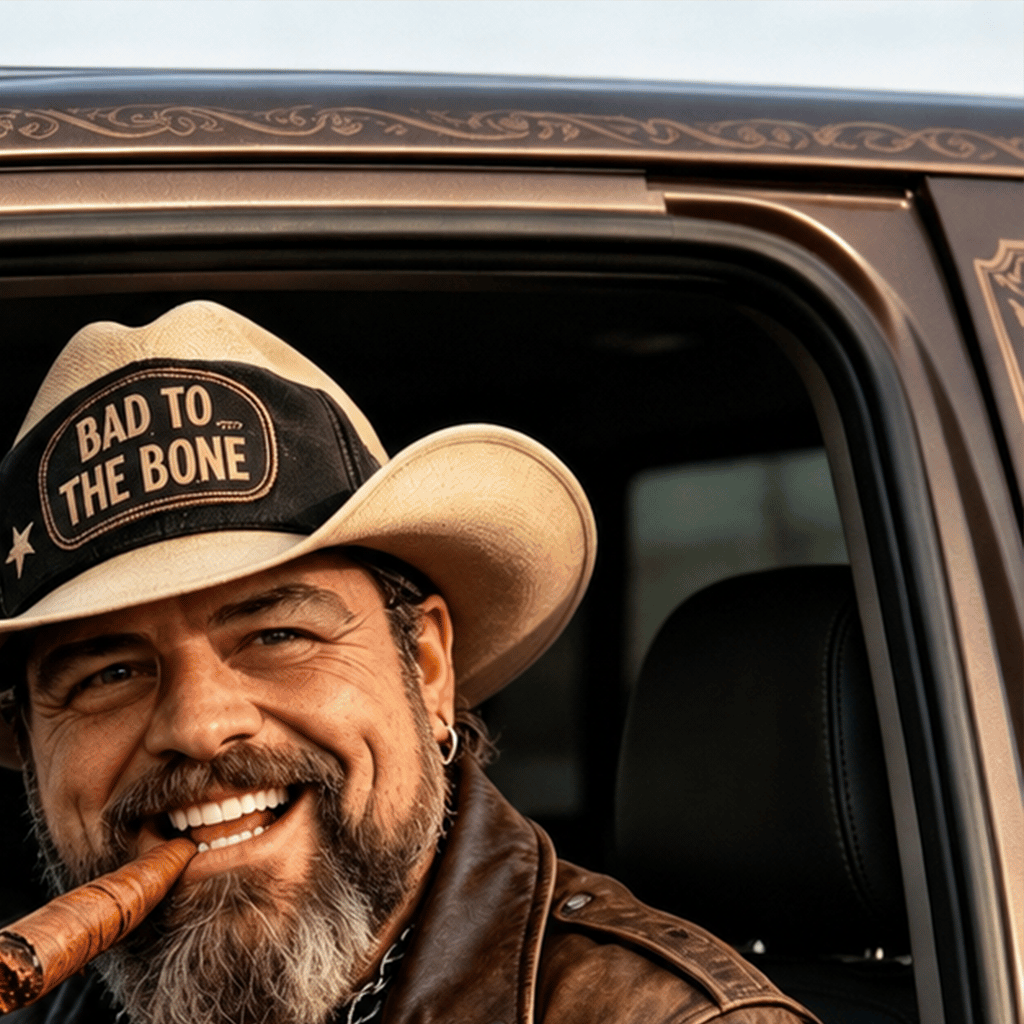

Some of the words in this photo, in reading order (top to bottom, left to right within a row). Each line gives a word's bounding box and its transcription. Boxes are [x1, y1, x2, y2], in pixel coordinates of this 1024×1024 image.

[76, 393, 151, 463] BAD
[160, 385, 213, 429] TO
[59, 454, 130, 526] THE
[139, 435, 250, 493] BONE
